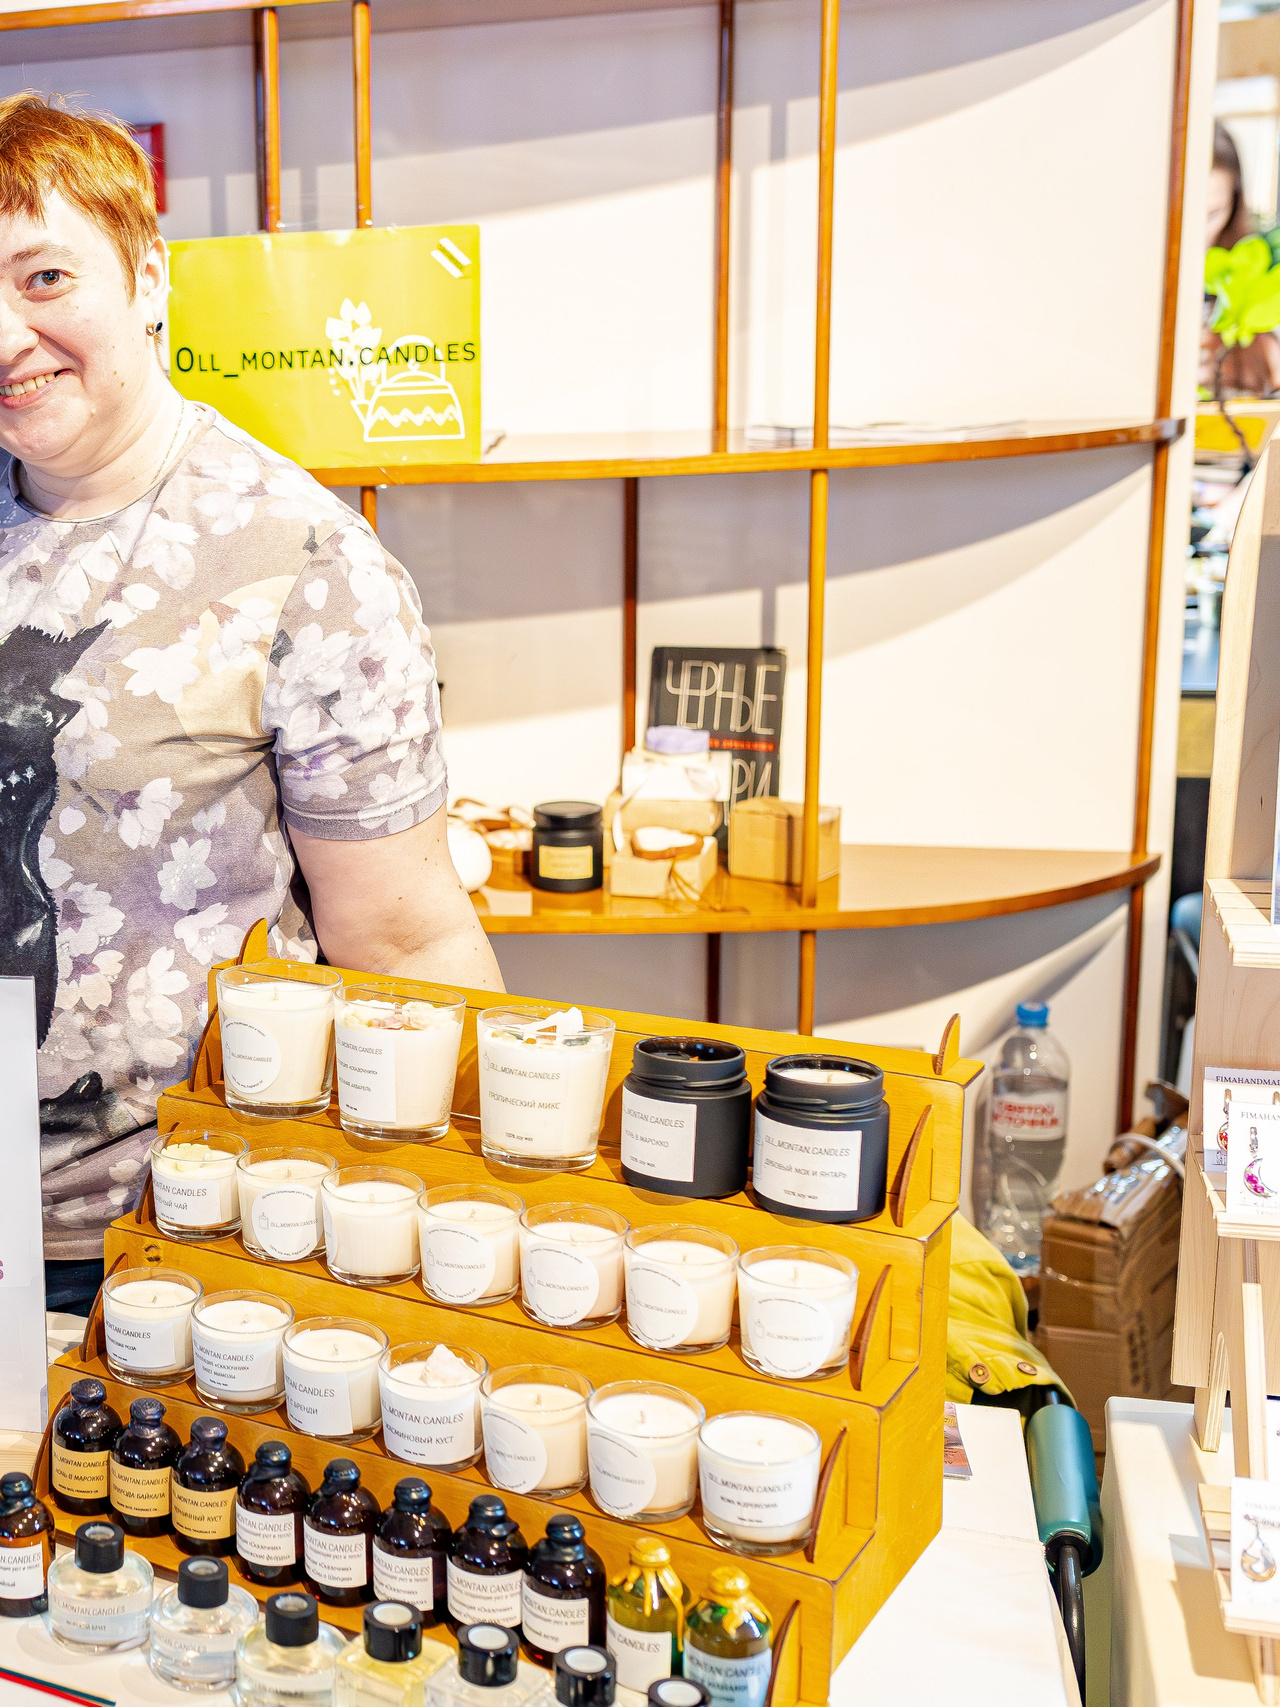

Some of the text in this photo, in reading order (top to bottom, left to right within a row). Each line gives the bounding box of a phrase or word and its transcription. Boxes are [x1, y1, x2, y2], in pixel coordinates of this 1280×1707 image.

[538, 1102, 561, 1110] МИКС
[639, 1135, 669, 1149] МАРОККО
[794, 1167, 811, 1177] МОХ
[811, 1169, 818, 1177] И
[174, 1201, 188, 1210] ЧАЙ
[294, 1403, 318, 1415] БРЕНДИ
[435, 1436, 454, 1445] КУСТ
[74, 1474, 105, 1482] МАРОККО
[136, 1491, 166, 1500] БАЙКАЛА
